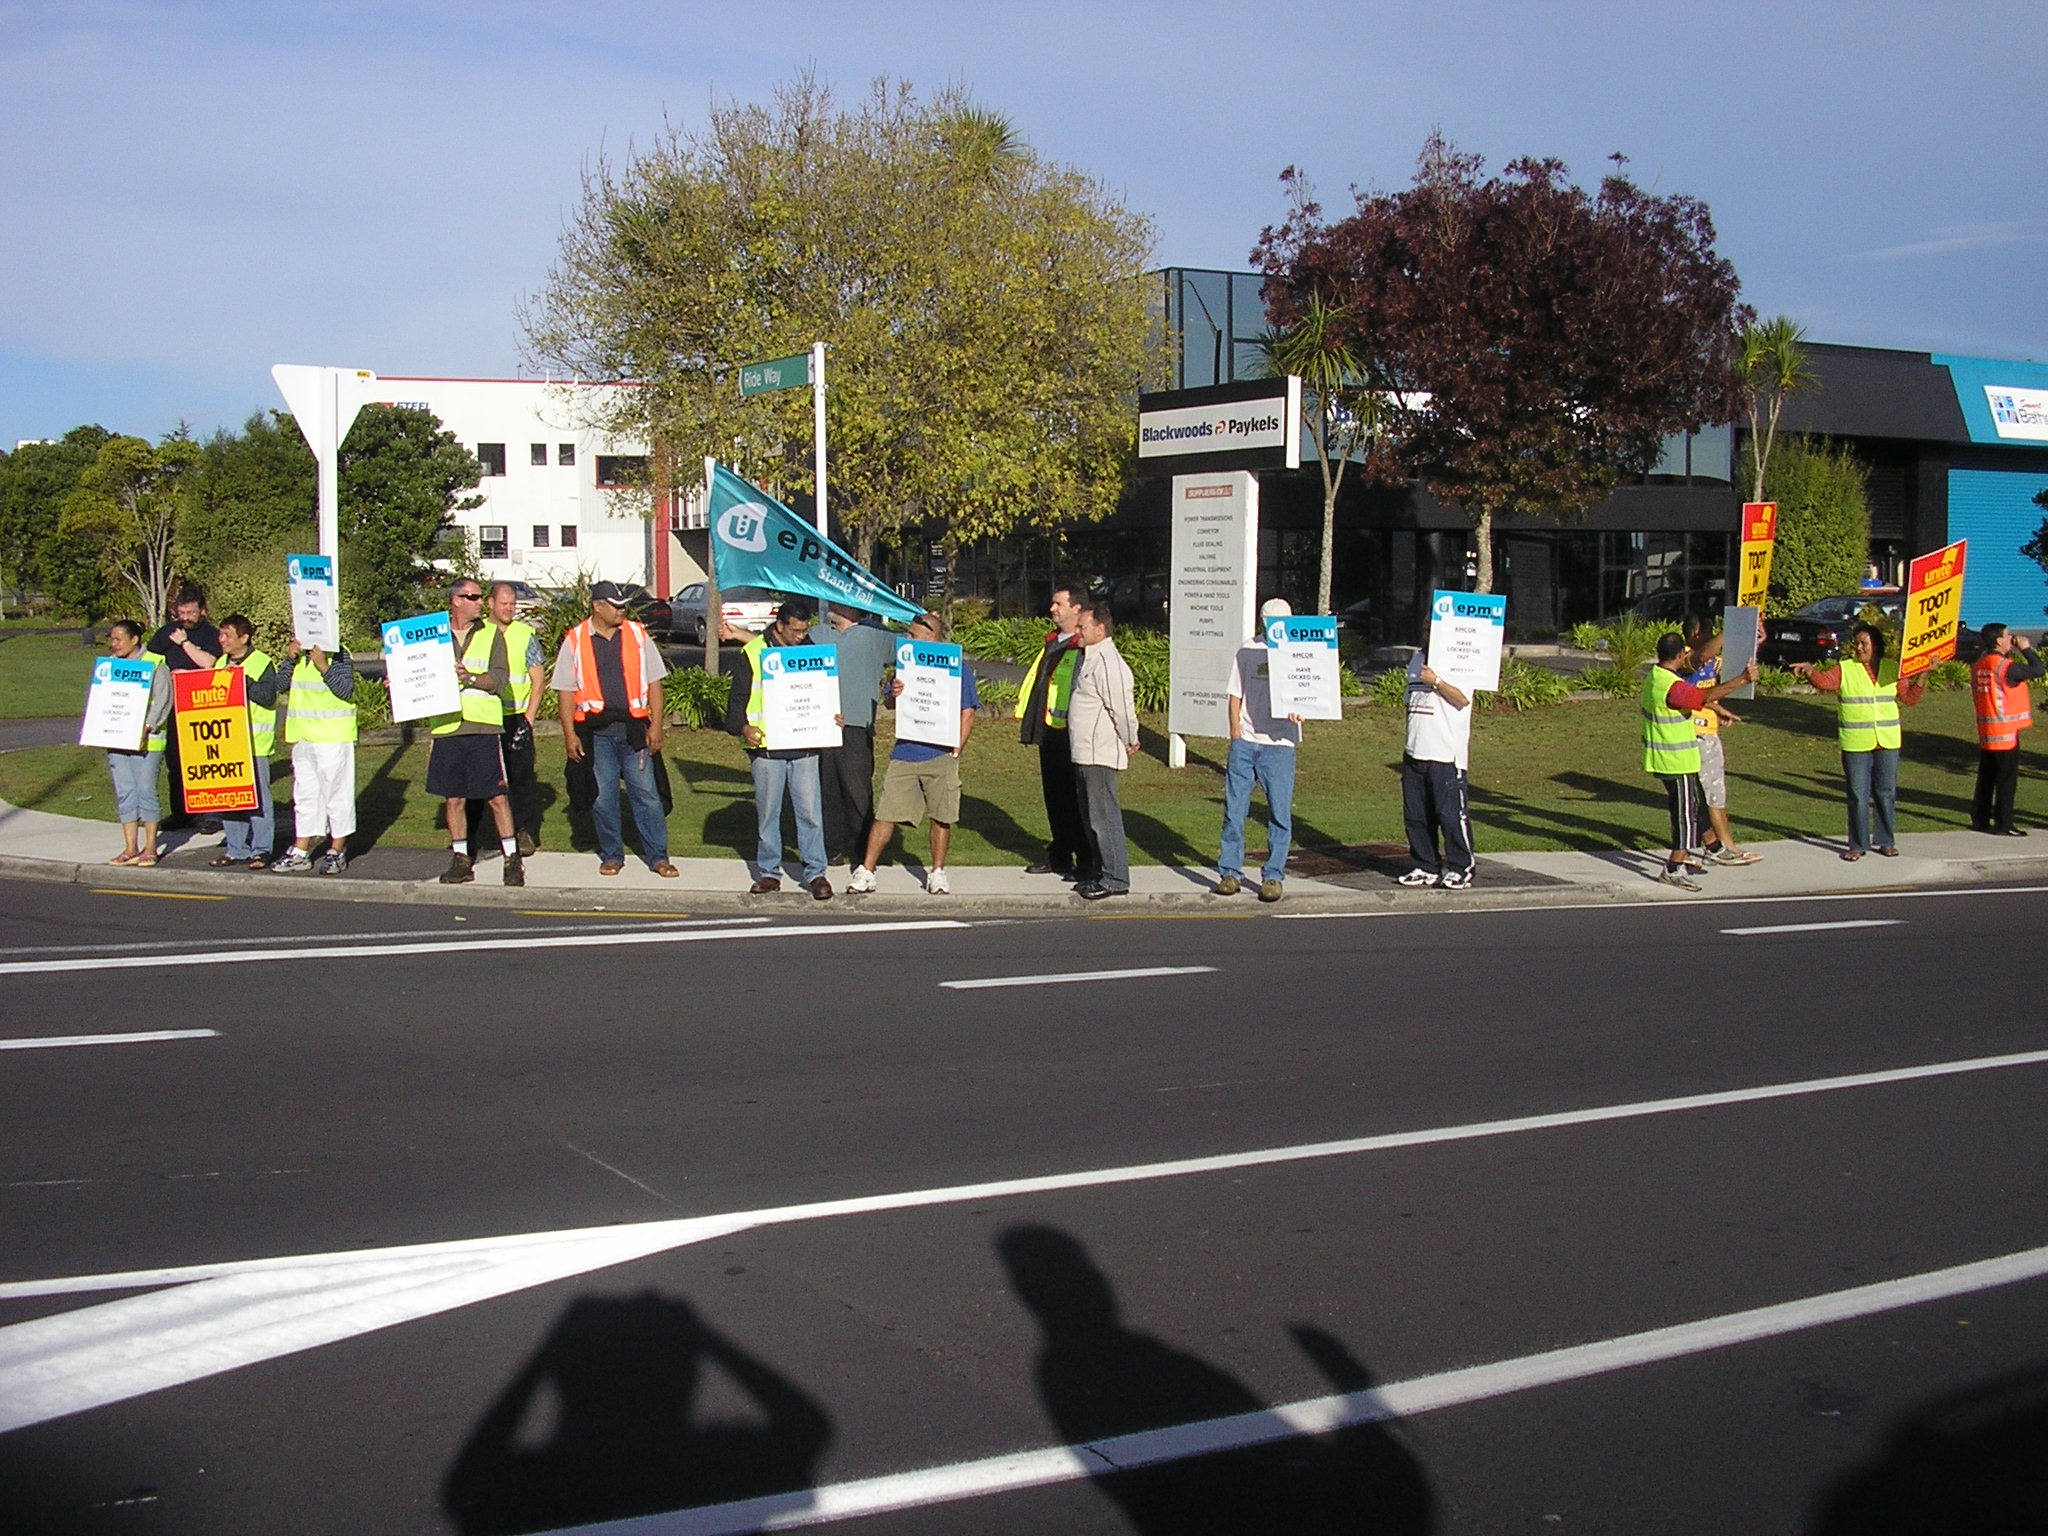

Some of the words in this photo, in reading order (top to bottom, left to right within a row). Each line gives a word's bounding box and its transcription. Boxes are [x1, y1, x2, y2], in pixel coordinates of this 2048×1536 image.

[744, 372, 762, 388] Ride
[764, 368, 781, 386] Way
[1142, 422, 1213, 443] Blackwoods
[1228, 416, 1279, 437] Paykels
[1749, 551, 1766, 570] TOOT
[303, 566, 331, 577] epmu
[1924, 563, 1953, 583] unite
[818, 567, 854, 594] Stand
[855, 585, 873, 605] Tall
[1457, 604, 1502, 616] epmu
[1919, 588, 1952, 616] TOOT
[1928, 612, 1939, 628] IN
[406, 624, 448, 641] epmu
[1290, 628, 1335, 641] epmu
[1907, 621, 1953, 651] SUPPORT
[787, 656, 835, 670] epmu
[918, 653, 958, 667] epmu
[114, 669, 150, 680] epmu
[191, 687, 226, 704] unite
[189, 718, 232, 741] TOOT
[206, 743, 220, 760] IN
[187, 761, 244, 780] SUPPORT
[188, 791, 254, 807] unite.org.nz
